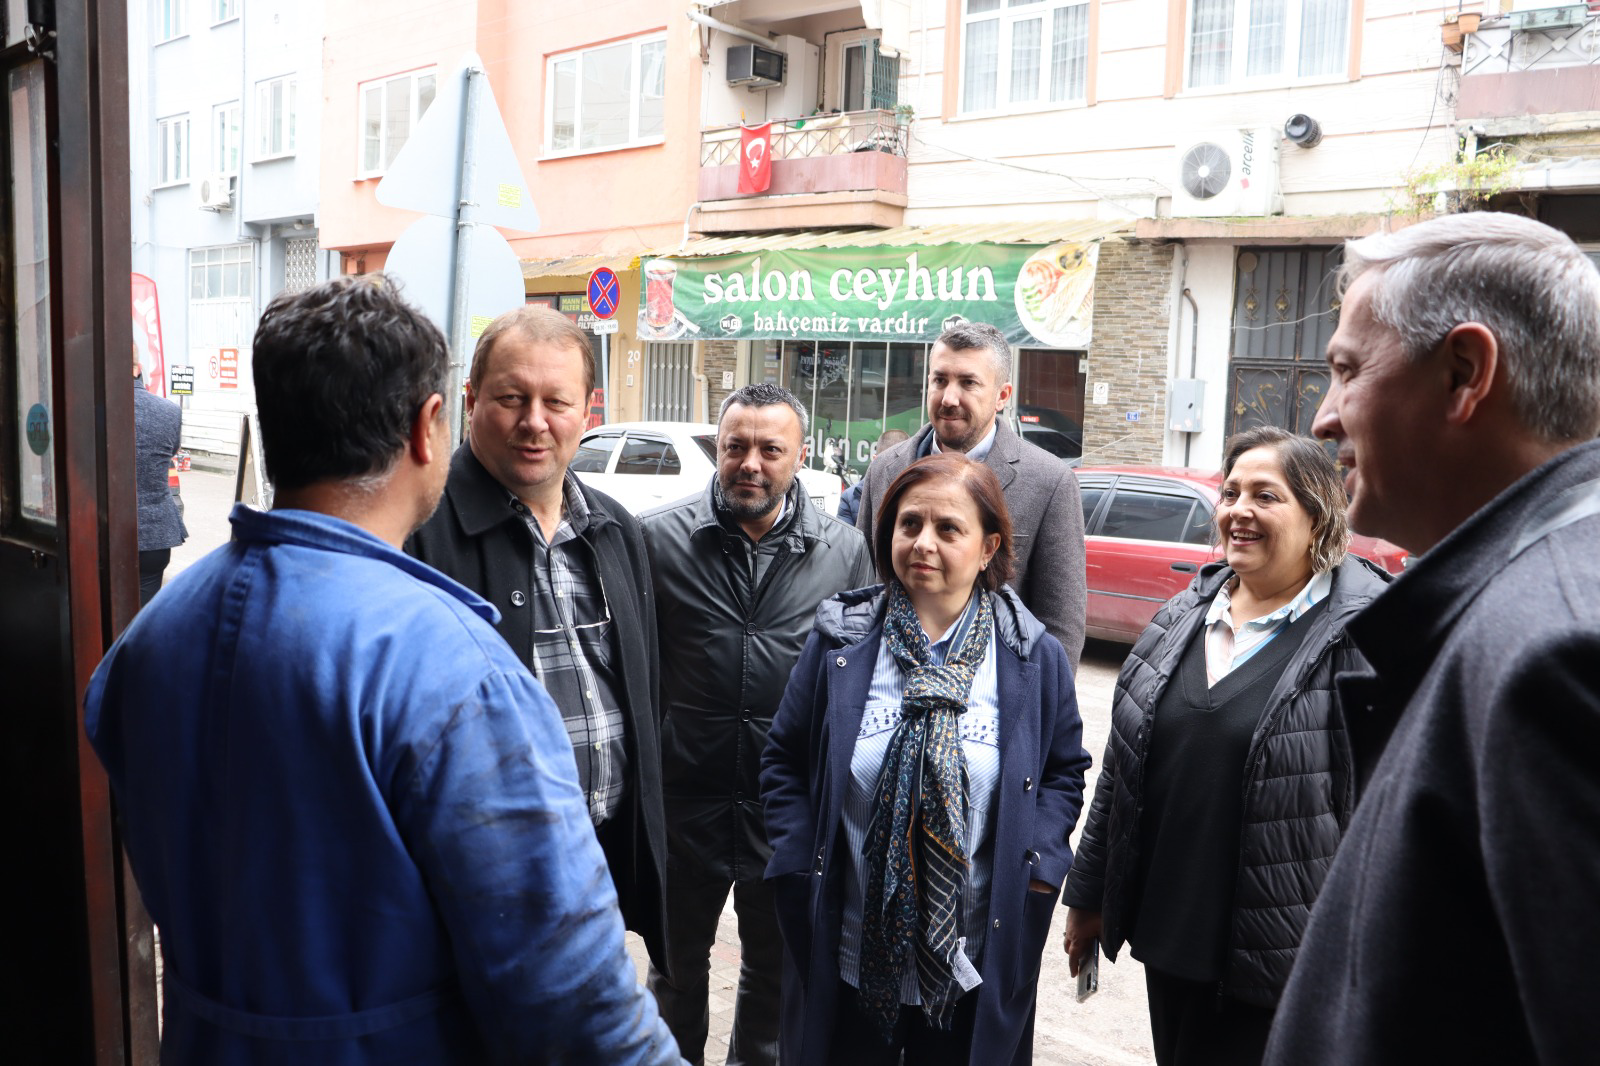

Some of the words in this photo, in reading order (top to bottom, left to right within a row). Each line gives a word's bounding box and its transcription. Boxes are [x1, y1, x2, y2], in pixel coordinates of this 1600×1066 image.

[702, 255, 815, 304] salon
[829, 250, 998, 311] ceyhun
[577, 321, 595, 330] FILTE
[753, 309, 850, 337] bahçemiz
[857, 310, 929, 334] vardır
[627, 350, 640, 362] 20
